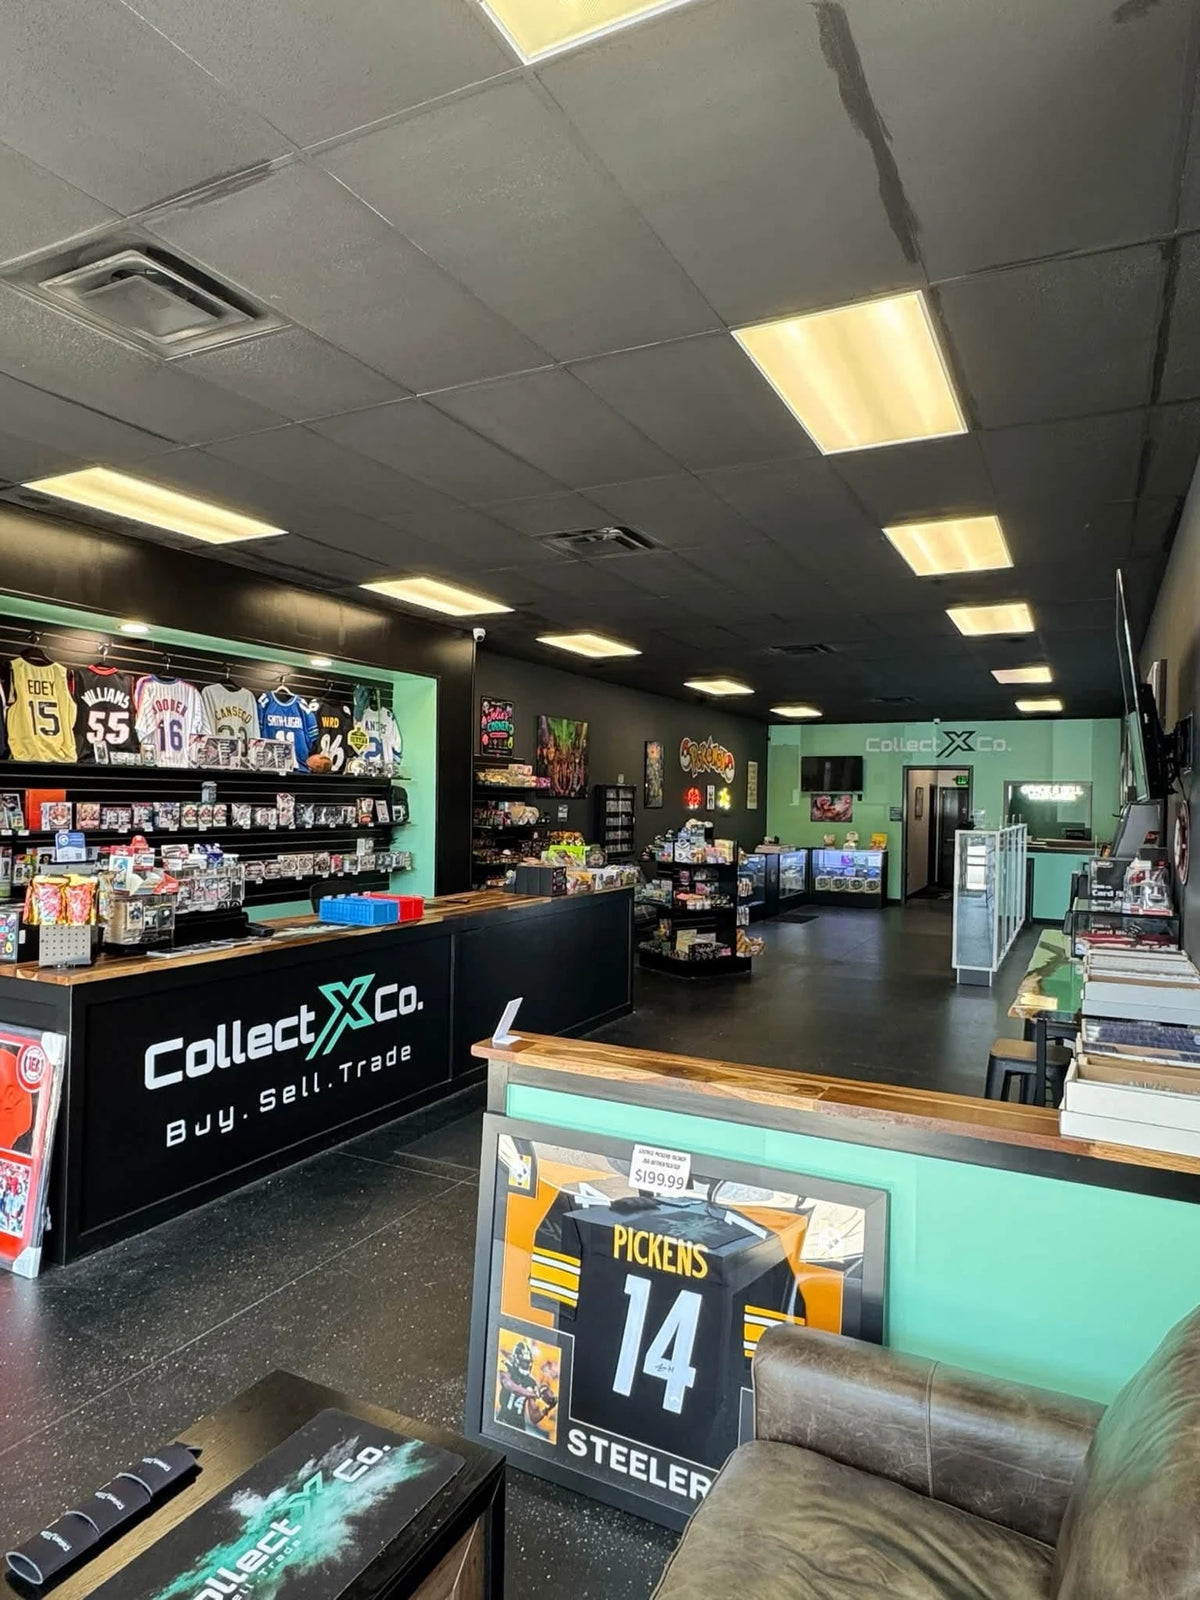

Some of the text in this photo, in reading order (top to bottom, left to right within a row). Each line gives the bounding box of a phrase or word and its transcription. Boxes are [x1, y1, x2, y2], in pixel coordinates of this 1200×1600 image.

[27, 679, 55, 696] EDEY
[80, 687, 131, 709] WILLIAMS
[28, 700, 60, 736] 15
[86, 710, 130, 745] 55
[215, 706, 252, 724] CANSECO
[156, 719, 183, 751] 16
[865, 737, 940, 753] Collect
[976, 736, 1012, 752] Co.
[144, 1004, 316, 1091] Collect
[374, 983, 424, 1023] Co.
[338, 1044, 412, 1083] Trade
[634, 1168, 685, 1190] $199.99
[612, 1224, 709, 1280] PICKENS
[612, 1273, 704, 1416] 14
[507, 1393, 526, 1415] 14
[567, 1427, 713, 1502] STEELER
[193, 1517, 303, 1600] ollect
[333, 1441, 392, 1484] Co.
